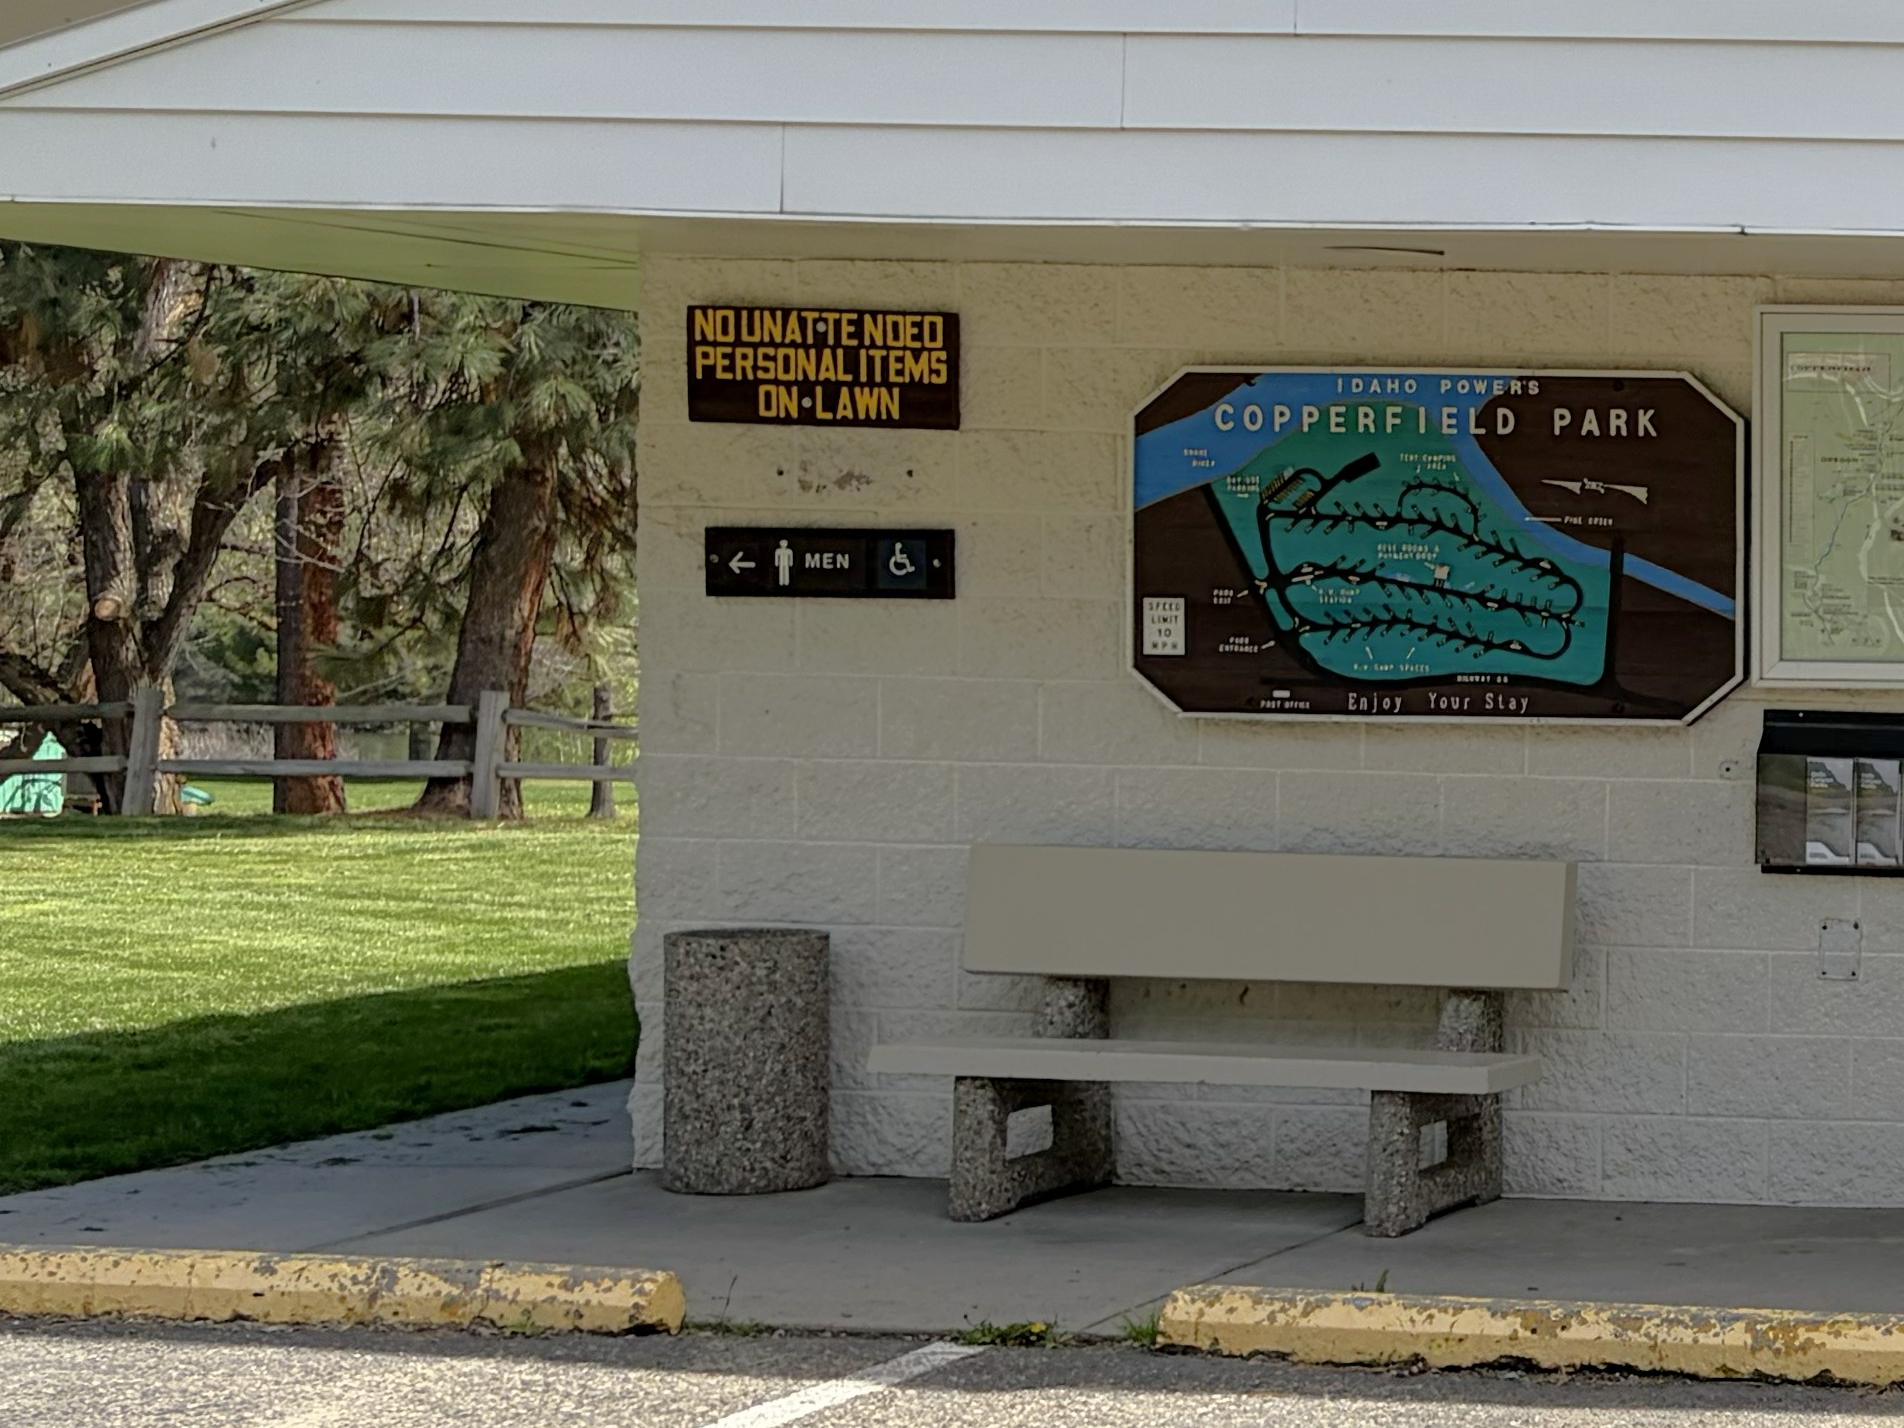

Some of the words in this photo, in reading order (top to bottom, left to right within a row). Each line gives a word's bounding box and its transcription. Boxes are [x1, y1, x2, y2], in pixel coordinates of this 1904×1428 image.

[694, 308, 735, 341] NO
[741, 309, 944, 347] UNATTENDED
[695, 346, 853, 380] PERSONAL
[859, 349, 949, 383] ITEMS
[1336, 377, 1418, 394] IDAHO
[1440, 379, 1540, 395] POWER'S
[758, 384, 799, 417] ON
[815, 385, 901, 419] LAWN
[1214, 403, 1516, 436] COPPERFIELD
[1553, 408, 1658, 438] PARK
[804, 552, 851, 570] MEN
[1148, 602, 1180, 611] SPEED
[1151, 615, 1178, 624] LIMIT
[1157, 628, 1172, 638] 10
[1348, 692, 1403, 713] Enjoy
[1428, 692, 1472, 710] Your
[1484, 693, 1529, 714] Stay
